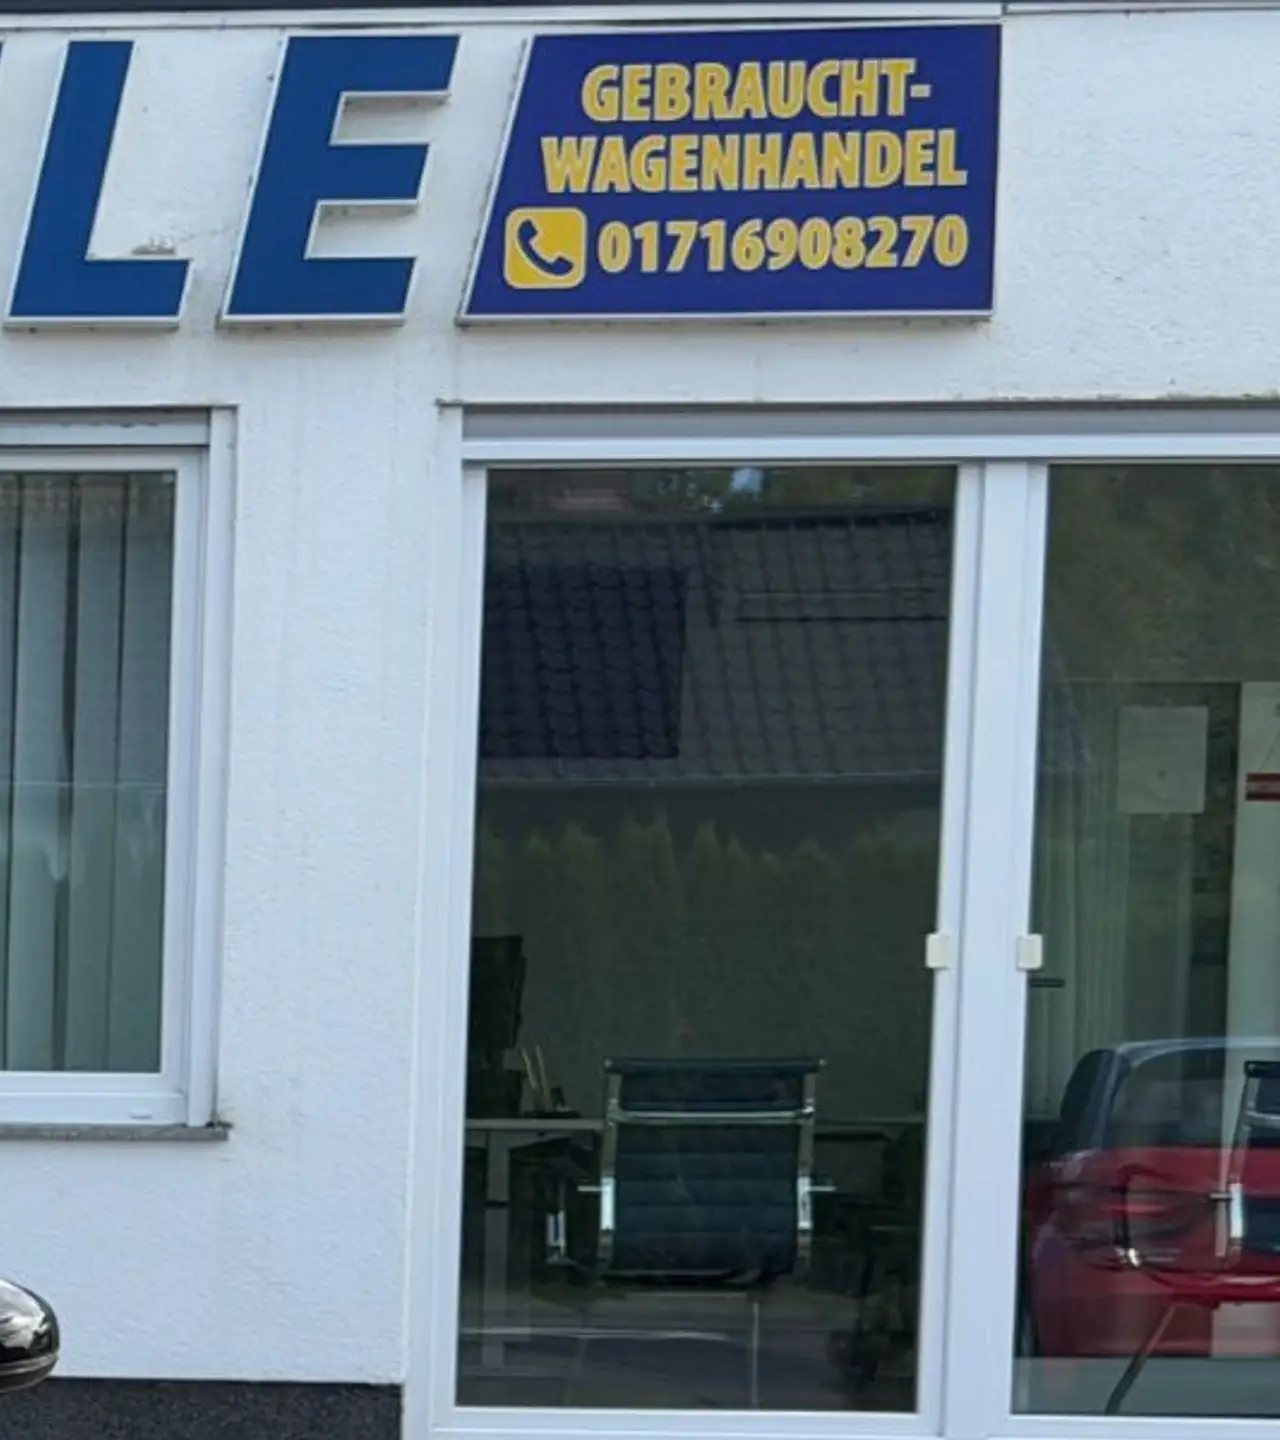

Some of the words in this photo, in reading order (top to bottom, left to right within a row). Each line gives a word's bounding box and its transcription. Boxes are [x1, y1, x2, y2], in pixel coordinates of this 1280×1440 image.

[581, 58, 932, 123] GEBRAUCHT-
[541, 129, 967, 194] WAGENHANDEL
[597, 215, 968, 273] 01716908270
